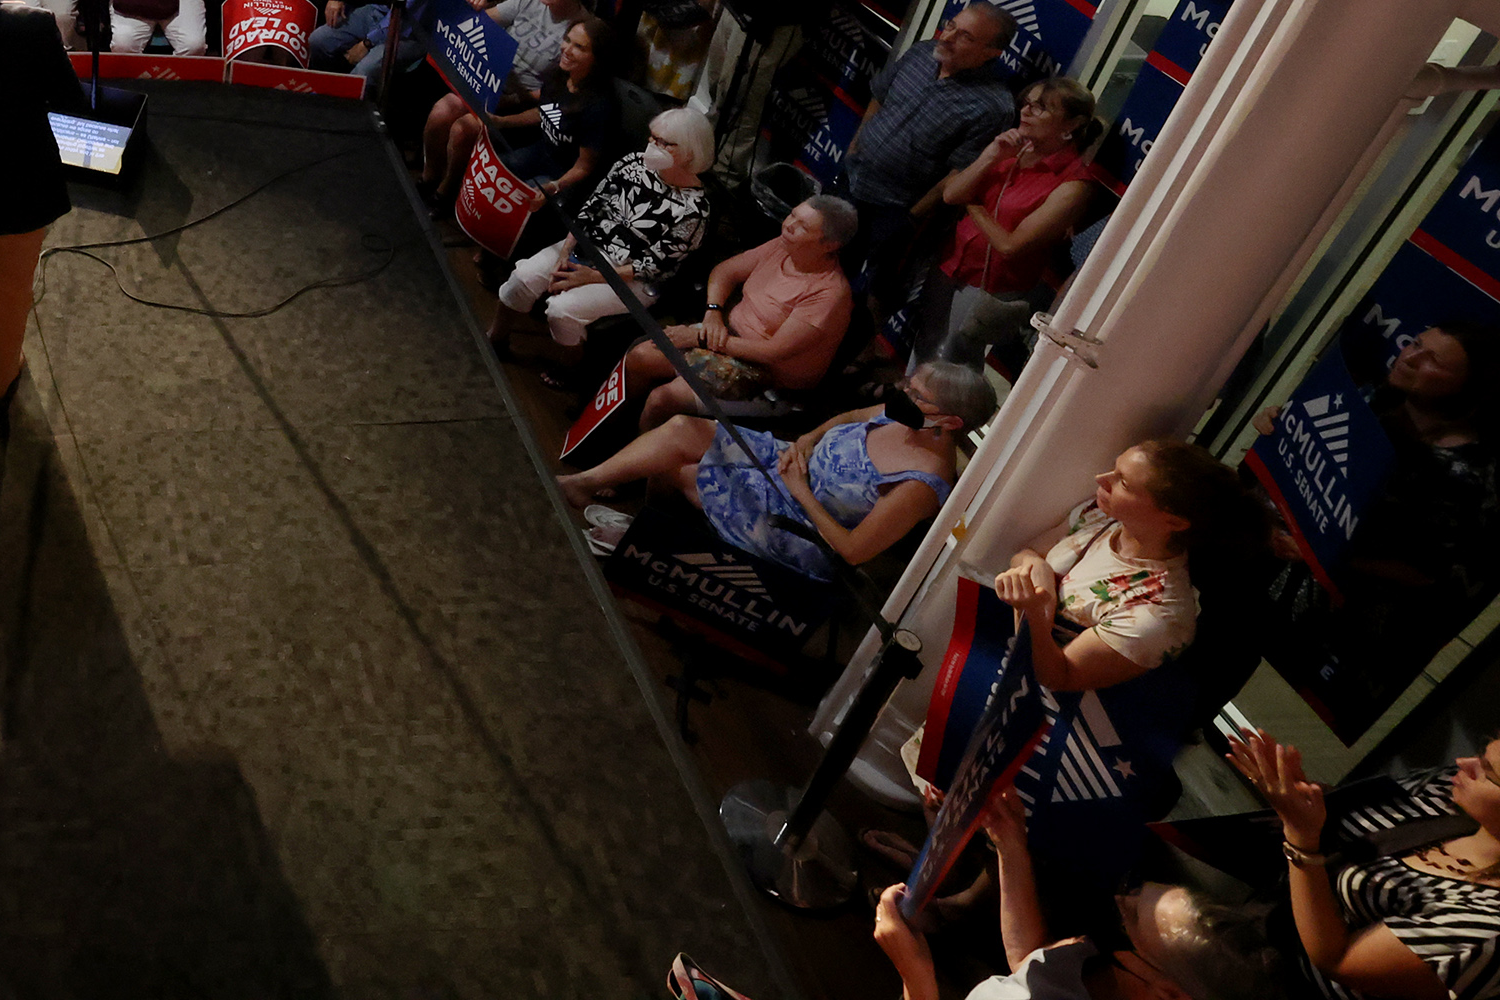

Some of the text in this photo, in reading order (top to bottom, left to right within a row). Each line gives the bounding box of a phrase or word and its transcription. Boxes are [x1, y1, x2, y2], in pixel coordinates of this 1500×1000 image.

[229, 17, 281, 39] LEAD
[242, 1, 293, 12] McMULLIN
[226, 29, 308, 60] COURAGE
[285, 22, 306, 44] TO
[437, 18, 500, 94] McMULLIN
[446, 47, 482, 95] U.S. SENATE
[471, 160, 513, 214] LEAD
[1277, 437, 1329, 535] U.S. SENATE
[623, 544, 809, 637] McMULLIN
[648, 573, 763, 633] U.S. SENATE
